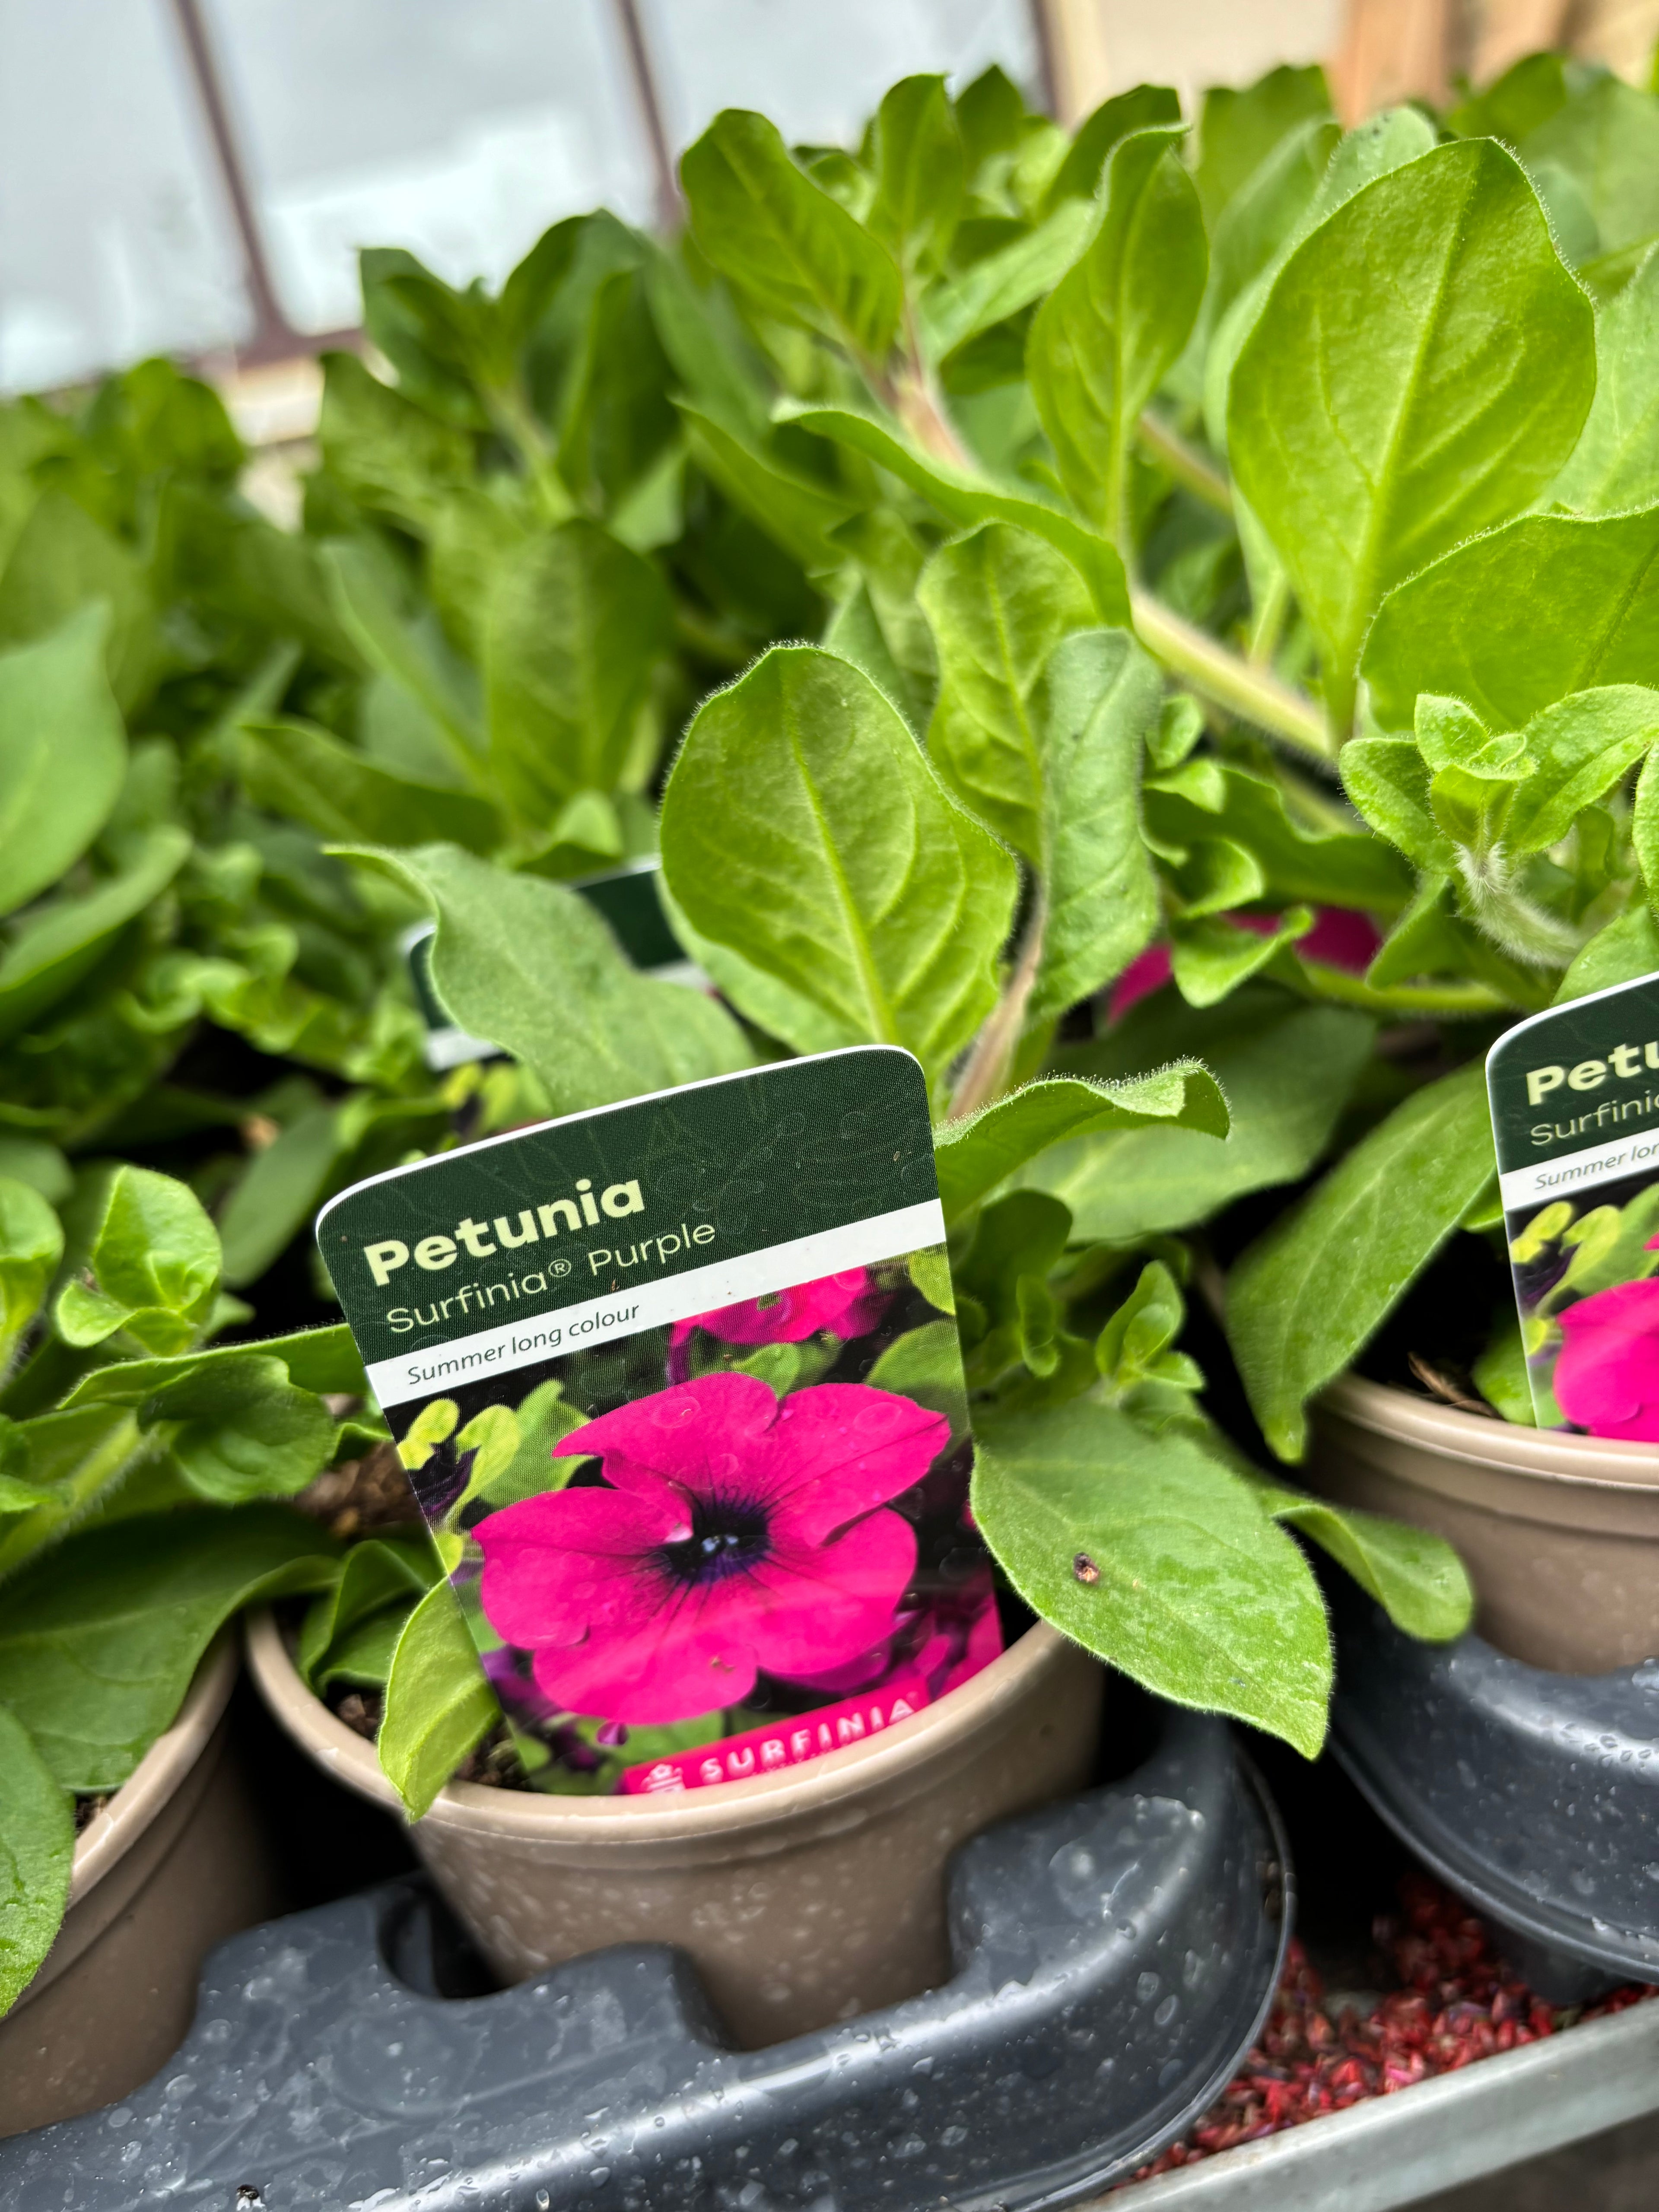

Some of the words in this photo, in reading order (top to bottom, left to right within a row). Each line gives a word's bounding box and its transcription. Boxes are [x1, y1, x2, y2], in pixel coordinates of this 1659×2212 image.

[1530, 1090, 1659, 1145] Surfini
[1534, 1152, 1627, 1189] Summer
[363, 1179, 645, 1287] Petunia
[387, 1258, 572, 1333] Surfinia®
[588, 1224, 716, 1276] Purple
[408, 1344, 505, 1385] Summer
[512, 1328, 561, 1354] long
[569, 1304, 639, 1336] colour
